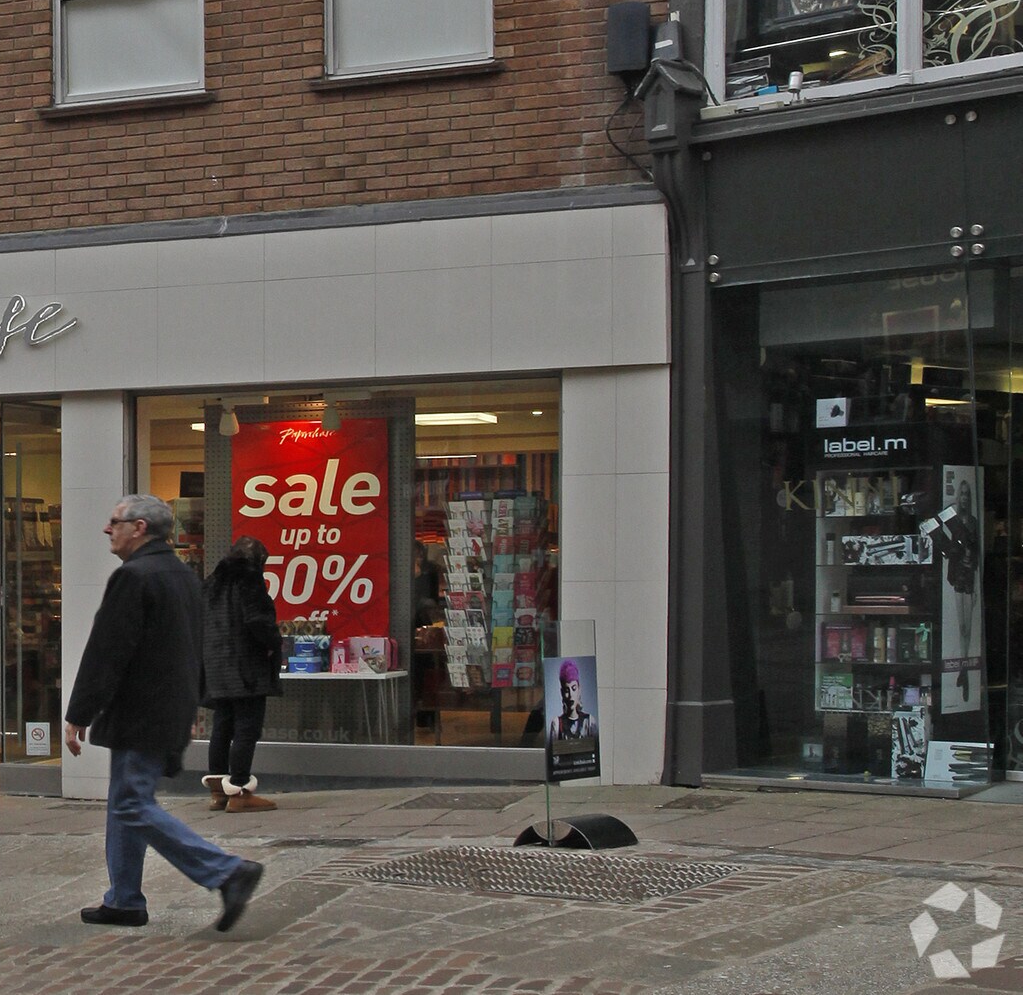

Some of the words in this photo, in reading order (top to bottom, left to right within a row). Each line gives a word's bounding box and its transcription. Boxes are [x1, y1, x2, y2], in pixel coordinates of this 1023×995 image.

[824, 436, 907, 453] label.m
[238, 458, 381, 518] sale
[280, 527, 312, 550] up
[317, 524, 341, 544] to
[263, 554, 374, 605] 50%
